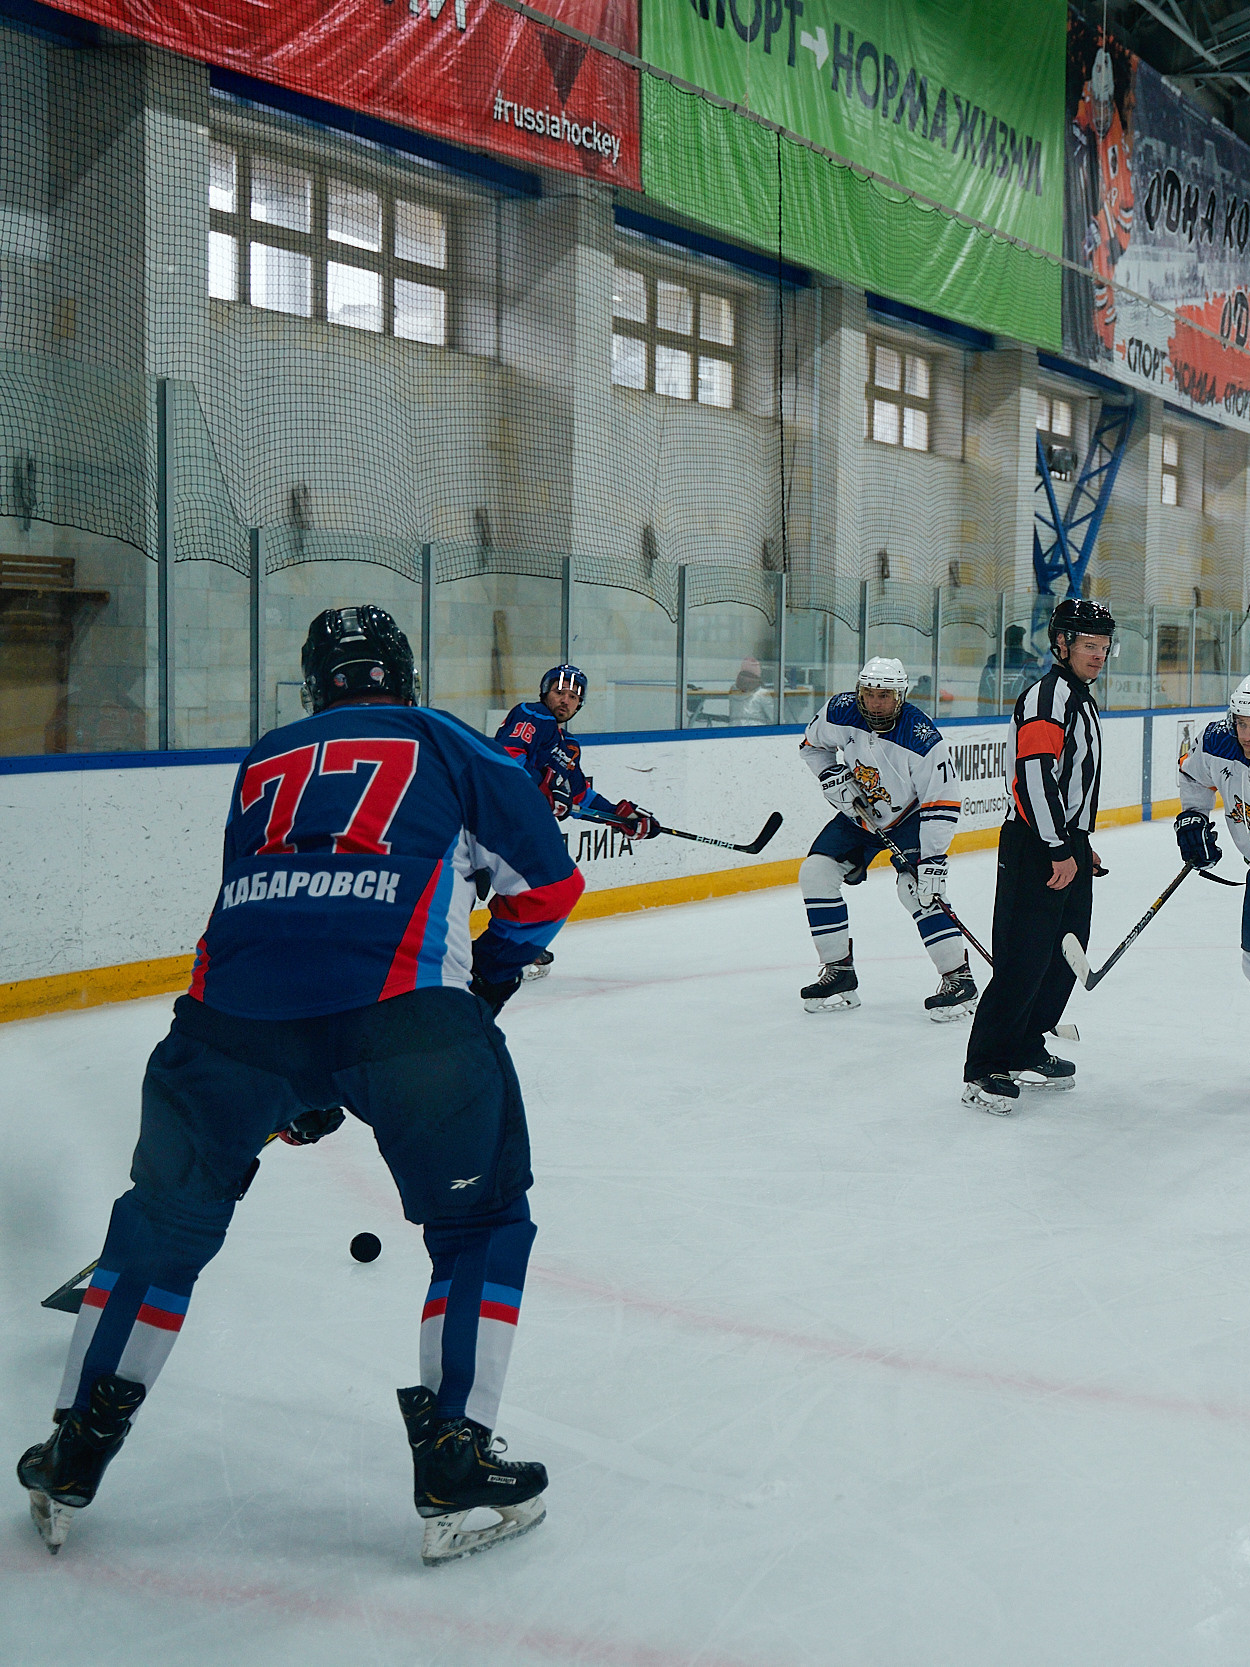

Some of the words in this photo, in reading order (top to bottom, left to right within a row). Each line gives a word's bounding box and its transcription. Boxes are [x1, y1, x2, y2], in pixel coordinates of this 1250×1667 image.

[689, 0, 804, 68] ОРТ
[831, 22, 948, 149] НОРМА
[950, 91, 1043, 197] ЖИЗНИ
[493, 89, 622, 166] #russiahockey
[1144, 168, 1216, 244] ОДНА
[1126, 335, 1168, 386] СПОРТ
[822, 771, 853, 791] BAUE
[936, 758, 956, 784] 71
[948, 742, 1007, 782] MURSCHO
[240, 737, 420, 855] 77
[576, 825, 633, 863] ЛИГА
[222, 869, 401, 910] ХАБАРОВСК
[923, 867, 949, 876] BAU
